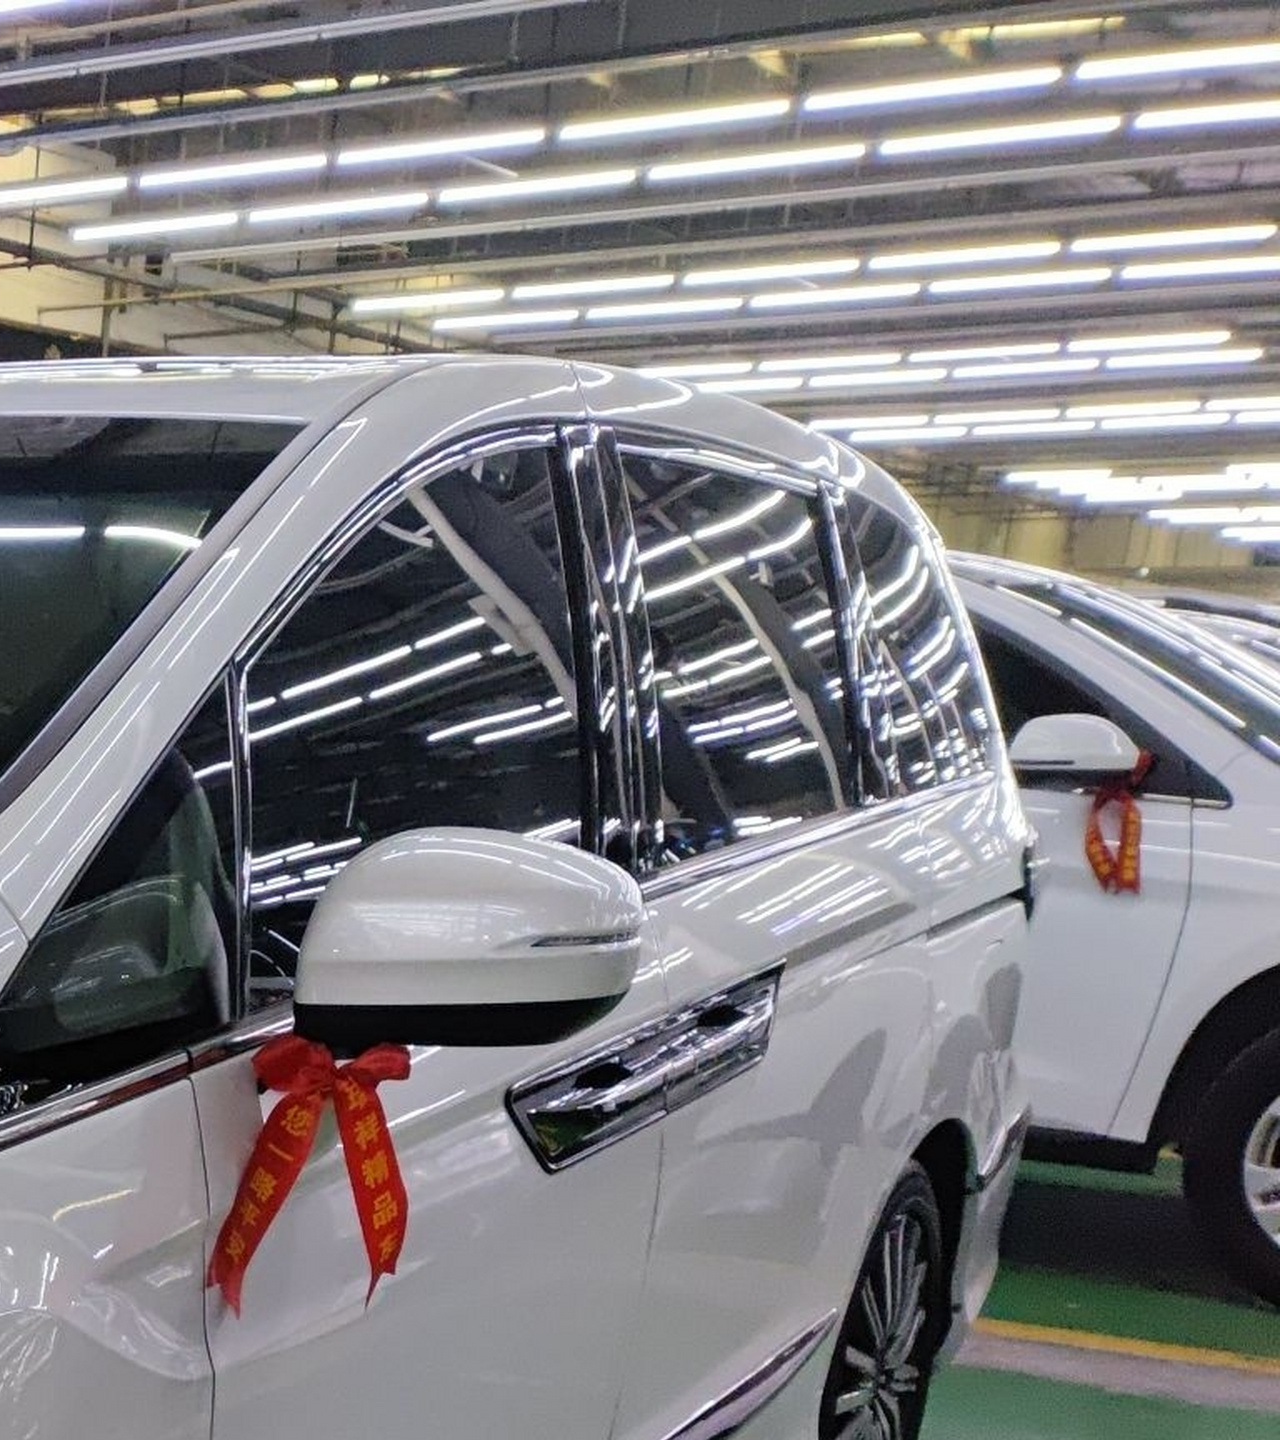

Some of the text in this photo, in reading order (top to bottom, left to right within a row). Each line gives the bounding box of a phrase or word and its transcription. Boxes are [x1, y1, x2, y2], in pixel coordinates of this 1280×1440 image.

[225, 1091, 322, 1263] 您一路平安
